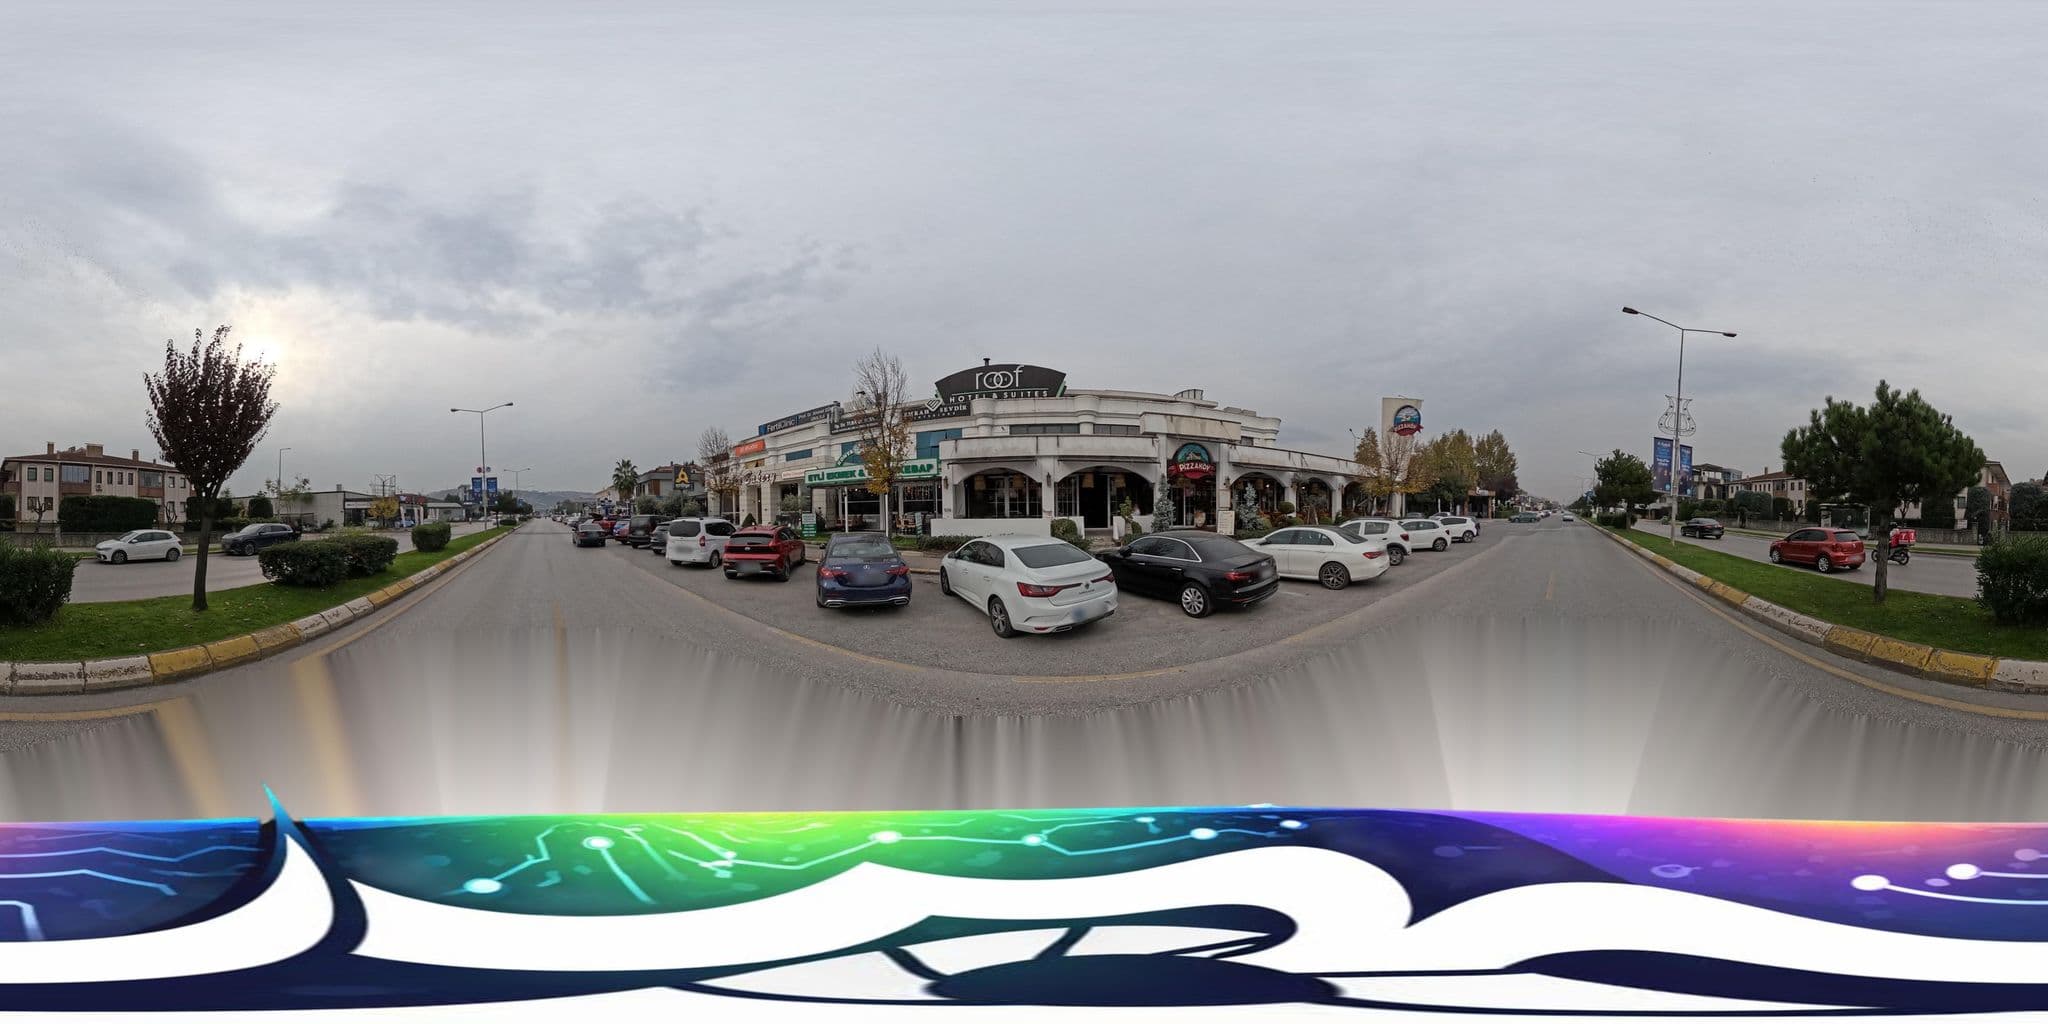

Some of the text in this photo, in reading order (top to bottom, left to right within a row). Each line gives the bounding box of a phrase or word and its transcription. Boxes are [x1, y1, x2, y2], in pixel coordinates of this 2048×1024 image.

[975, 365, 1024, 390] roof
[949, 394, 986, 404] HOTEL
[1003, 390, 1048, 399] SUITES
